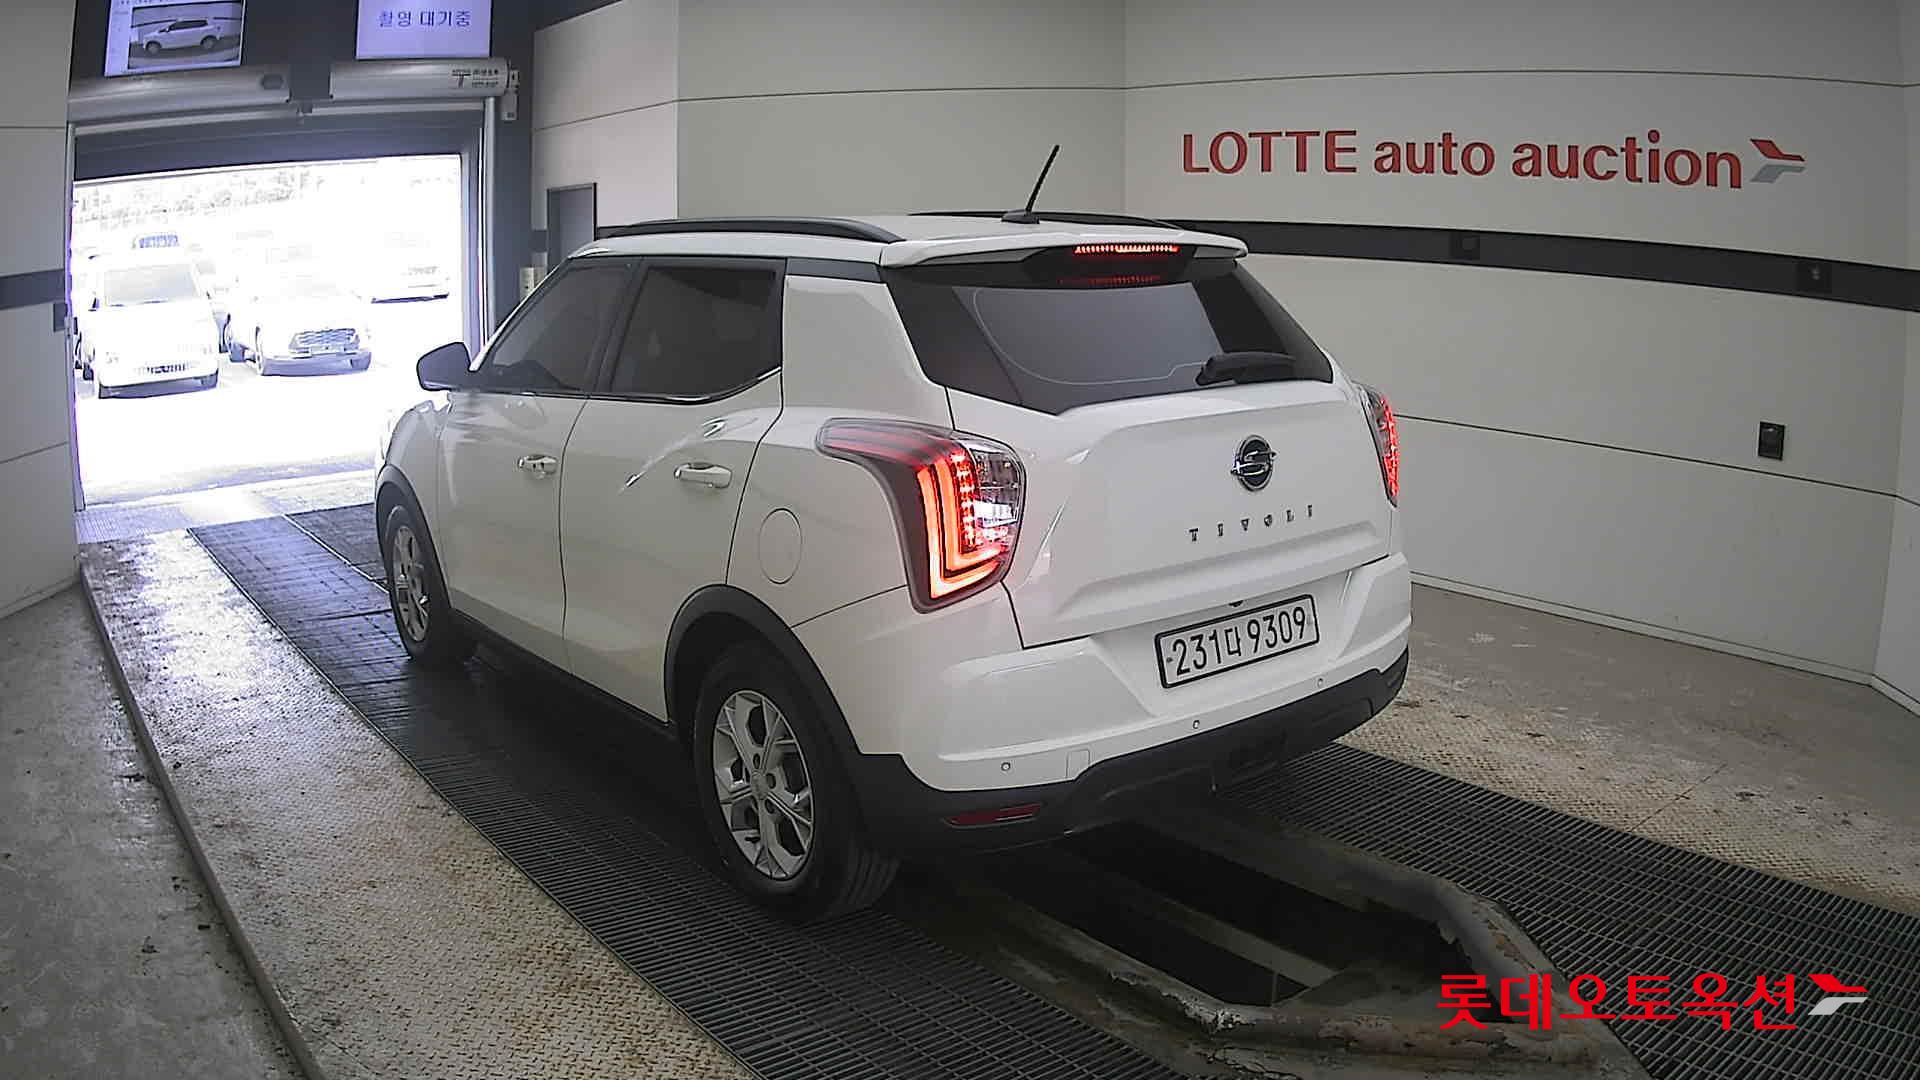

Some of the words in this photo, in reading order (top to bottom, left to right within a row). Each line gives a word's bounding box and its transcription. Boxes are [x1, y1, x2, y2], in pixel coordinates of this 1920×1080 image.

[420, 9, 470, 27] 대기중
[1184, 130, 1355, 174] LOTTE
[1374, 132, 1495, 177] auto
[1512, 129, 1742, 189] auction
[1189, 504, 1313, 542] TIVOLI
